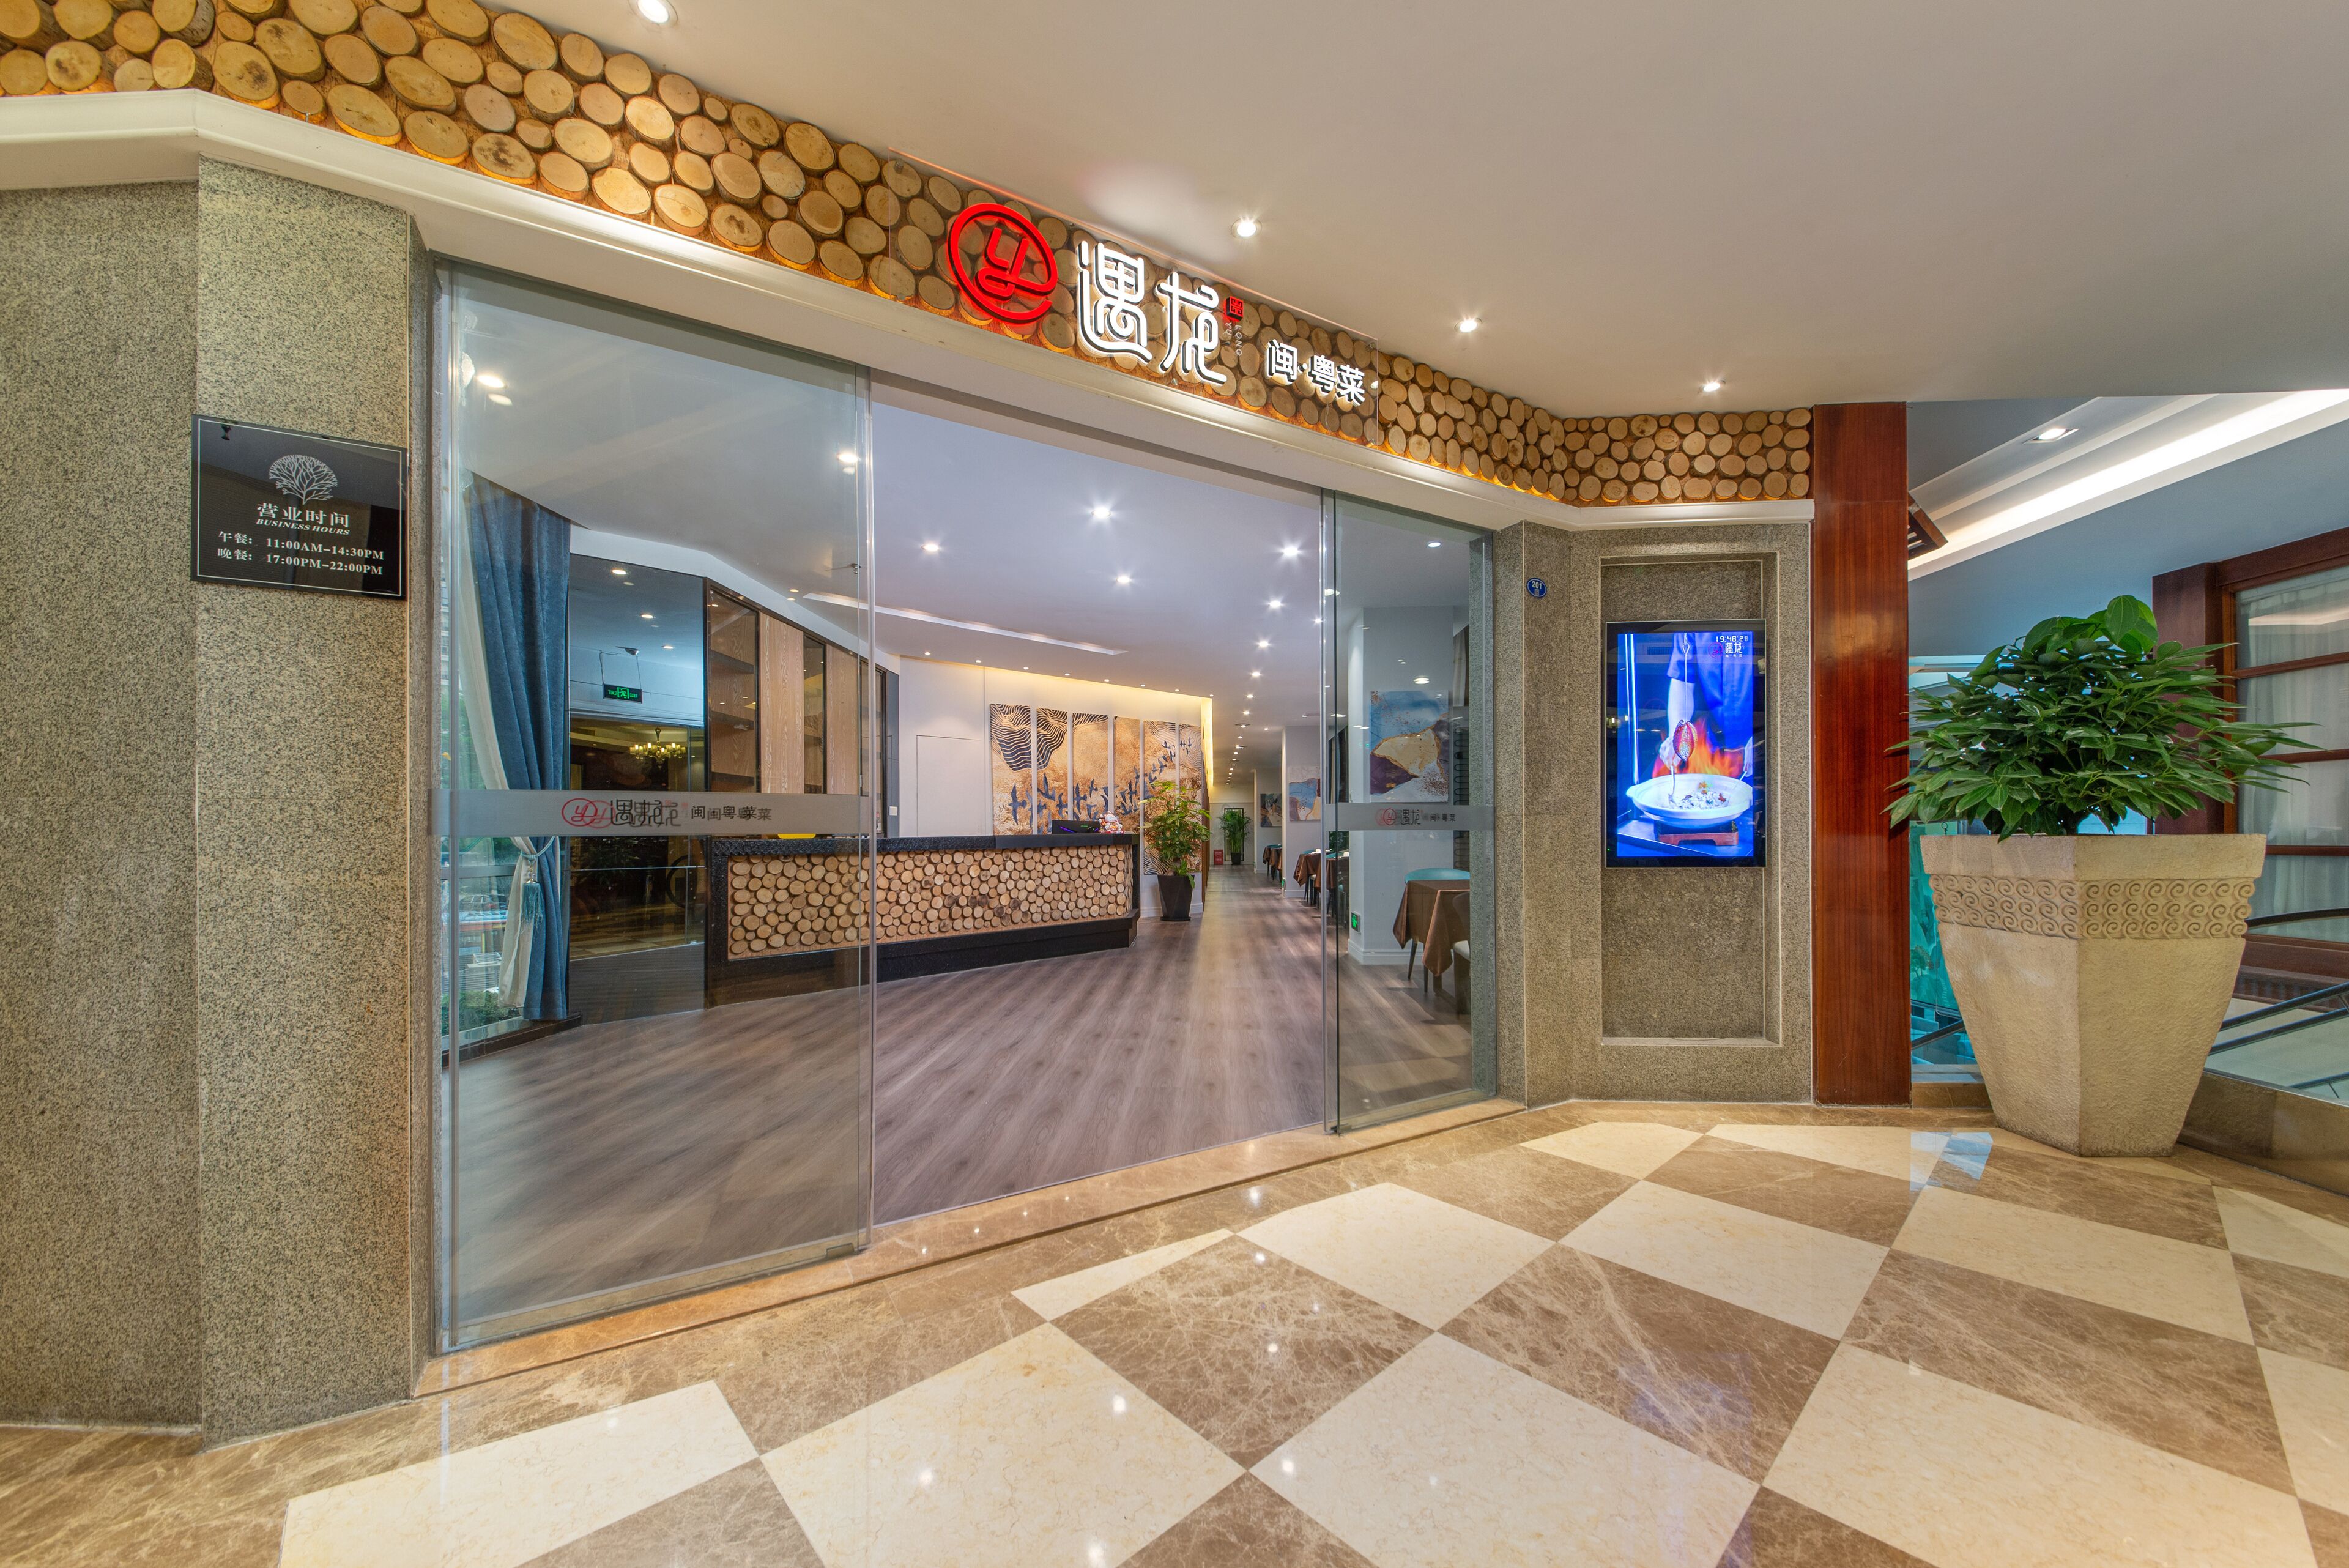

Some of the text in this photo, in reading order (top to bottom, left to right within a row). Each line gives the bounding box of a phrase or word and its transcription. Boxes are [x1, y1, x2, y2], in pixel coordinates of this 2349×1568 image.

[256, 502, 350, 528] 营业时间
[256, 518, 351, 536] BUSINESS HOURS
[218, 530, 253, 544] 午餐:
[217, 548, 253, 561] 晚餐:
[1532, 581, 1542, 590] 201
